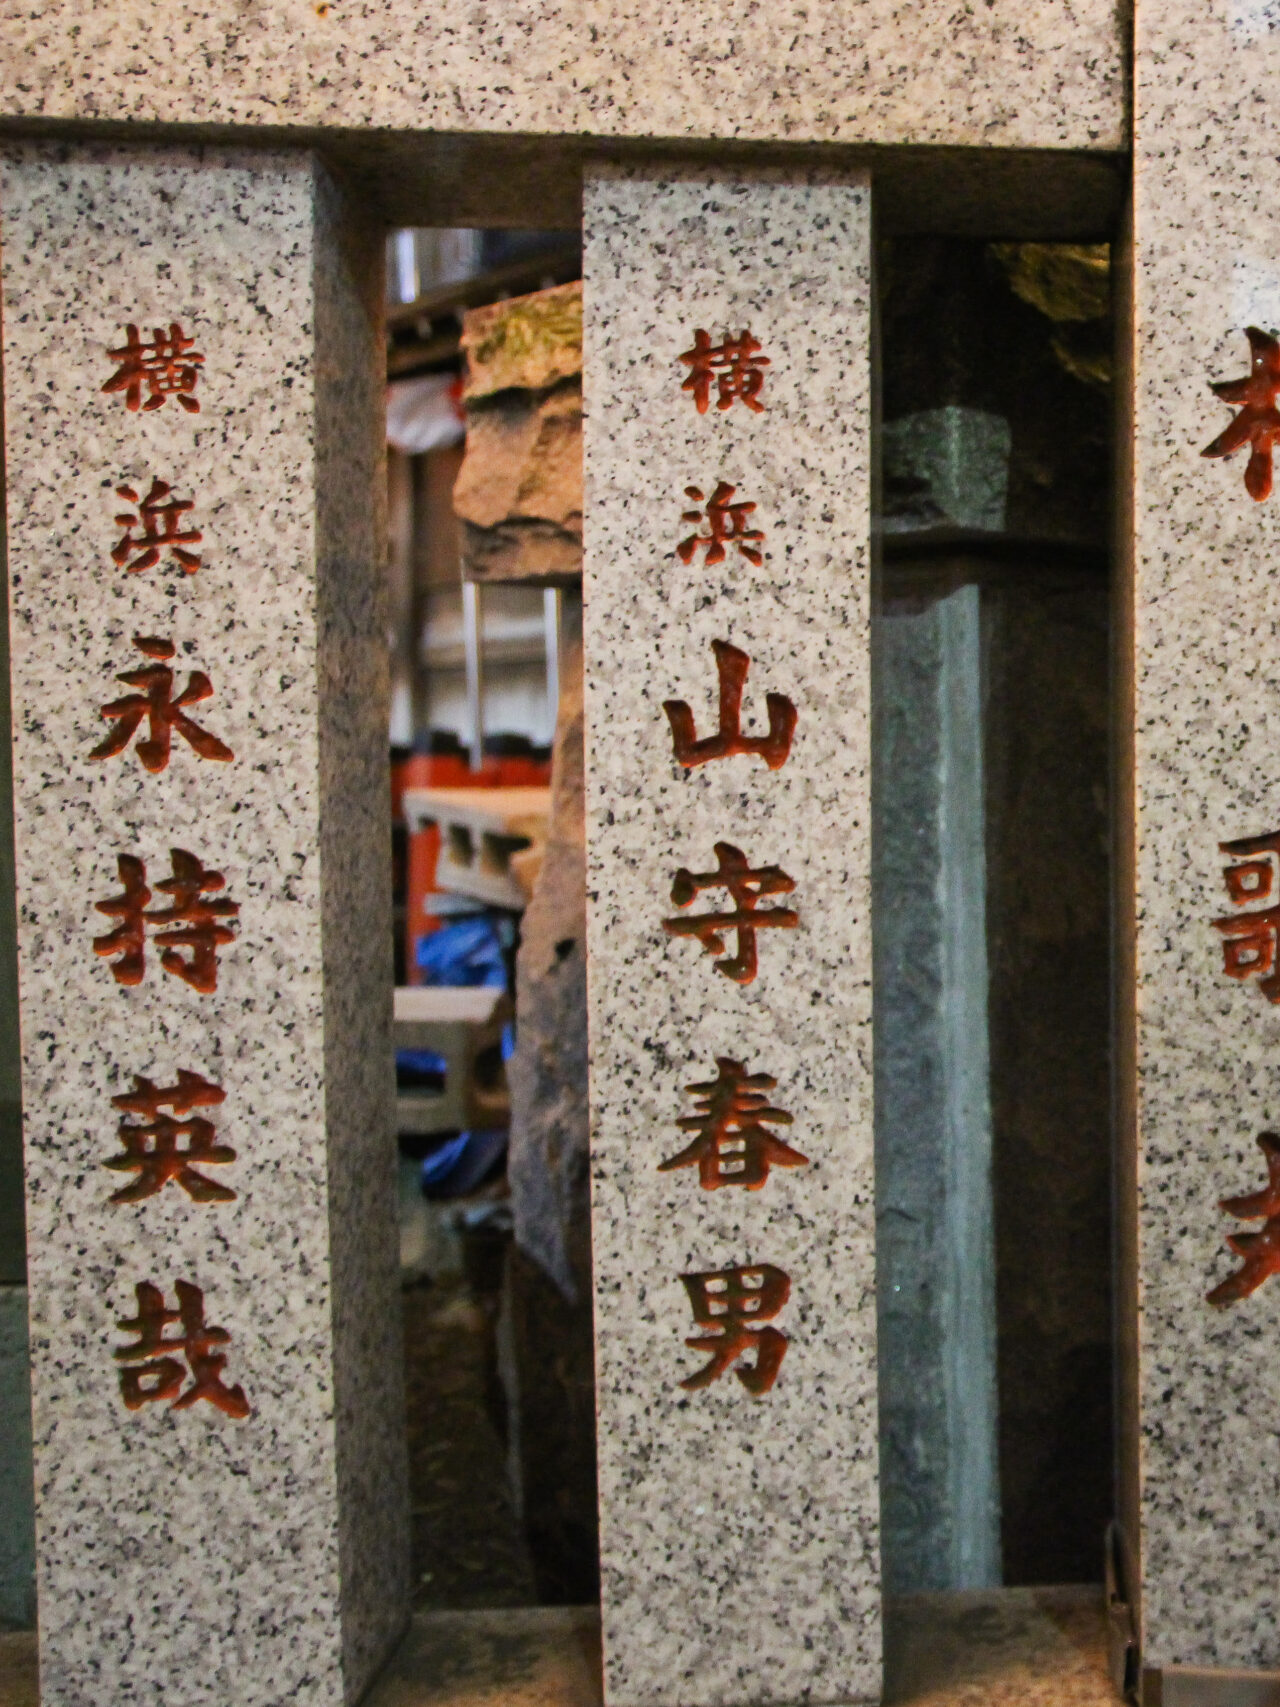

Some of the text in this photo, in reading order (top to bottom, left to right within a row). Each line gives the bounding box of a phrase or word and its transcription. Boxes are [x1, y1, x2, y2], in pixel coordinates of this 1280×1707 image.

[88, 321, 257, 1420] 横浜永持英哉
[661, 327, 810, 1397] 横浜山守春男
